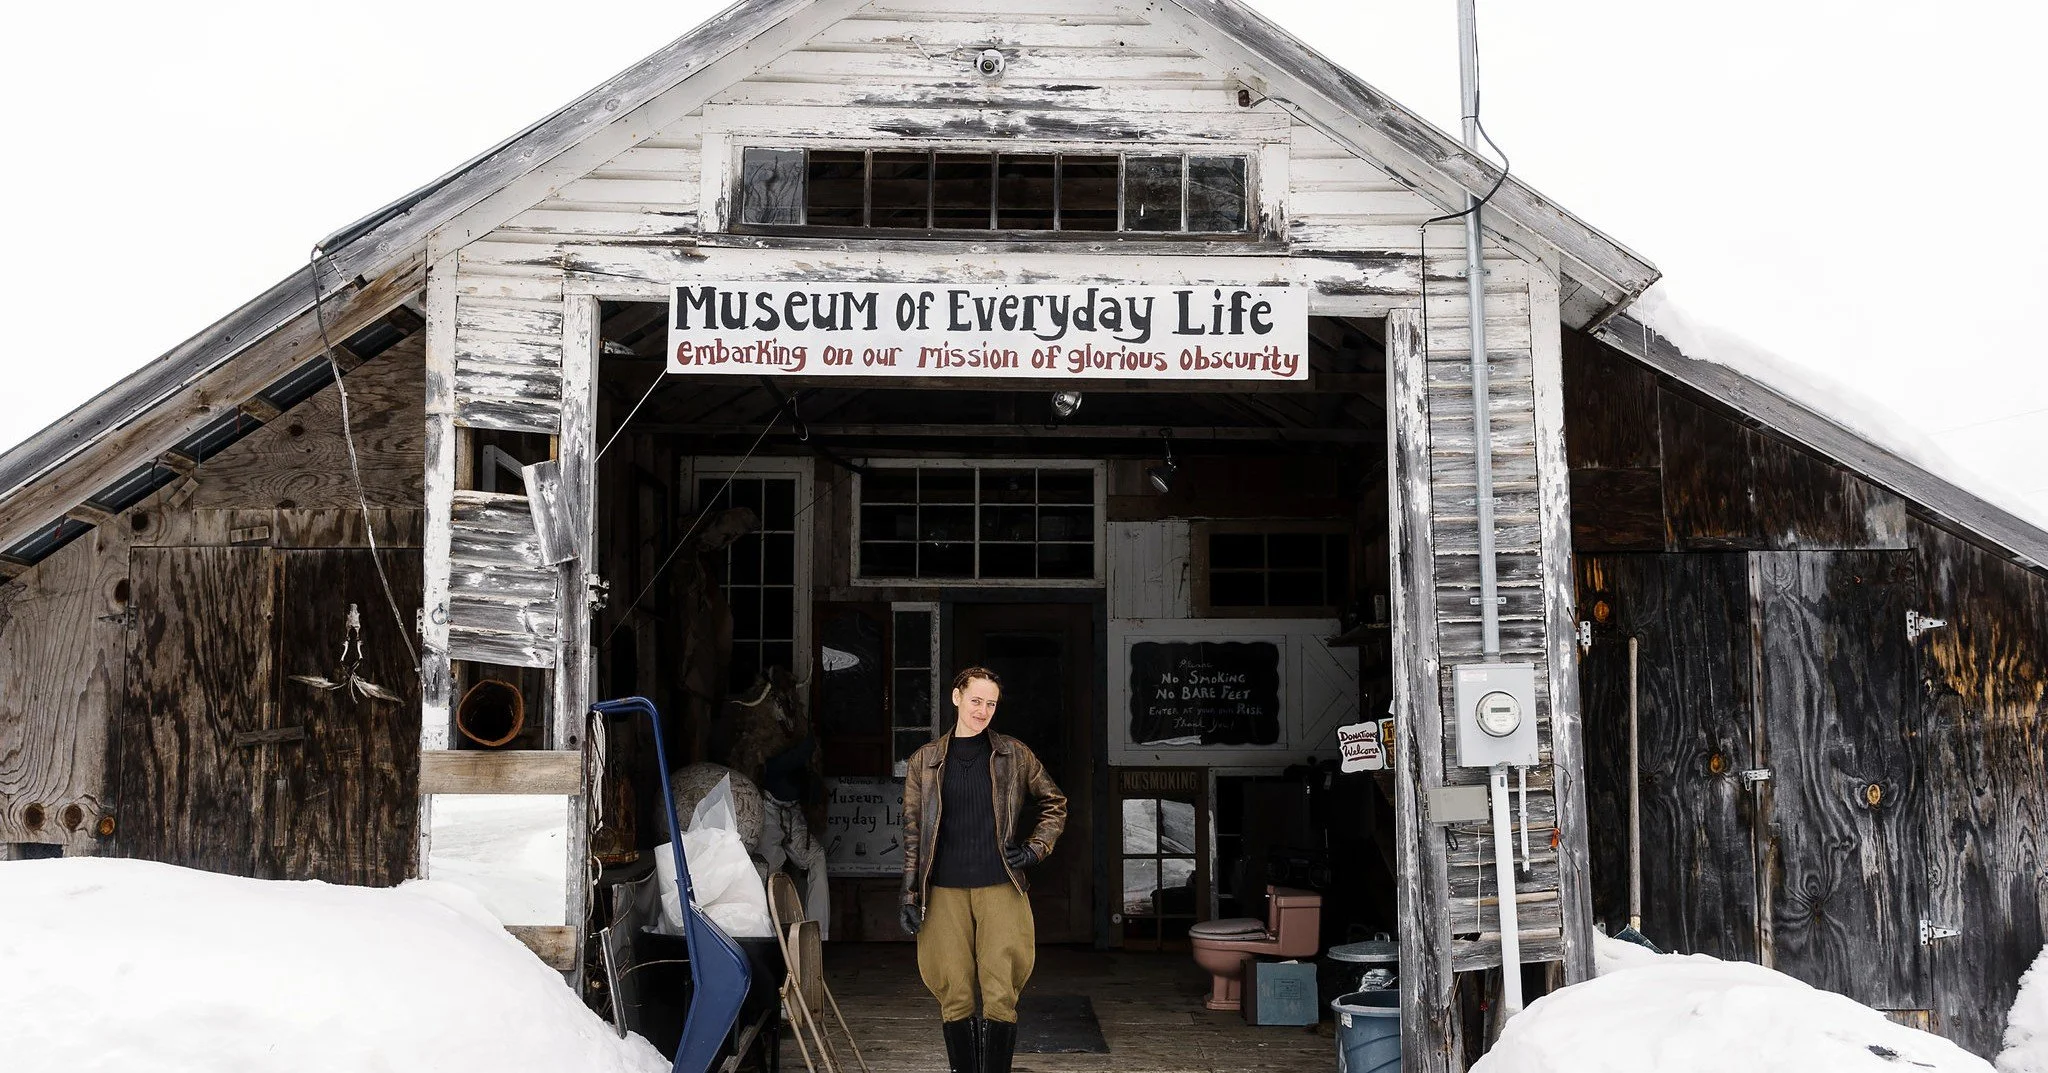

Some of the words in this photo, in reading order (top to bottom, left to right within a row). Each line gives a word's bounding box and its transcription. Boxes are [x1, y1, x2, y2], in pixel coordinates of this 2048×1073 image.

[896, 291, 935, 332] of
[947, 287, 1155, 344] Everyday
[1172, 288, 1274, 335] Life
[823, 345, 853, 366] on
[863, 347, 903, 367] our
[917, 341, 1019, 369] mission
[1032, 345, 1062, 370] of
[1067, 343, 1168, 374] glorious
[1179, 345, 1299, 378] obscurity
[1181, 686, 1216, 701] BARE
[1342, 744, 1380, 758] Welcome
[1123, 771, 1139, 790] NO
[1142, 771, 1198, 791] SMOKING
[827, 805, 877, 834] eryday
